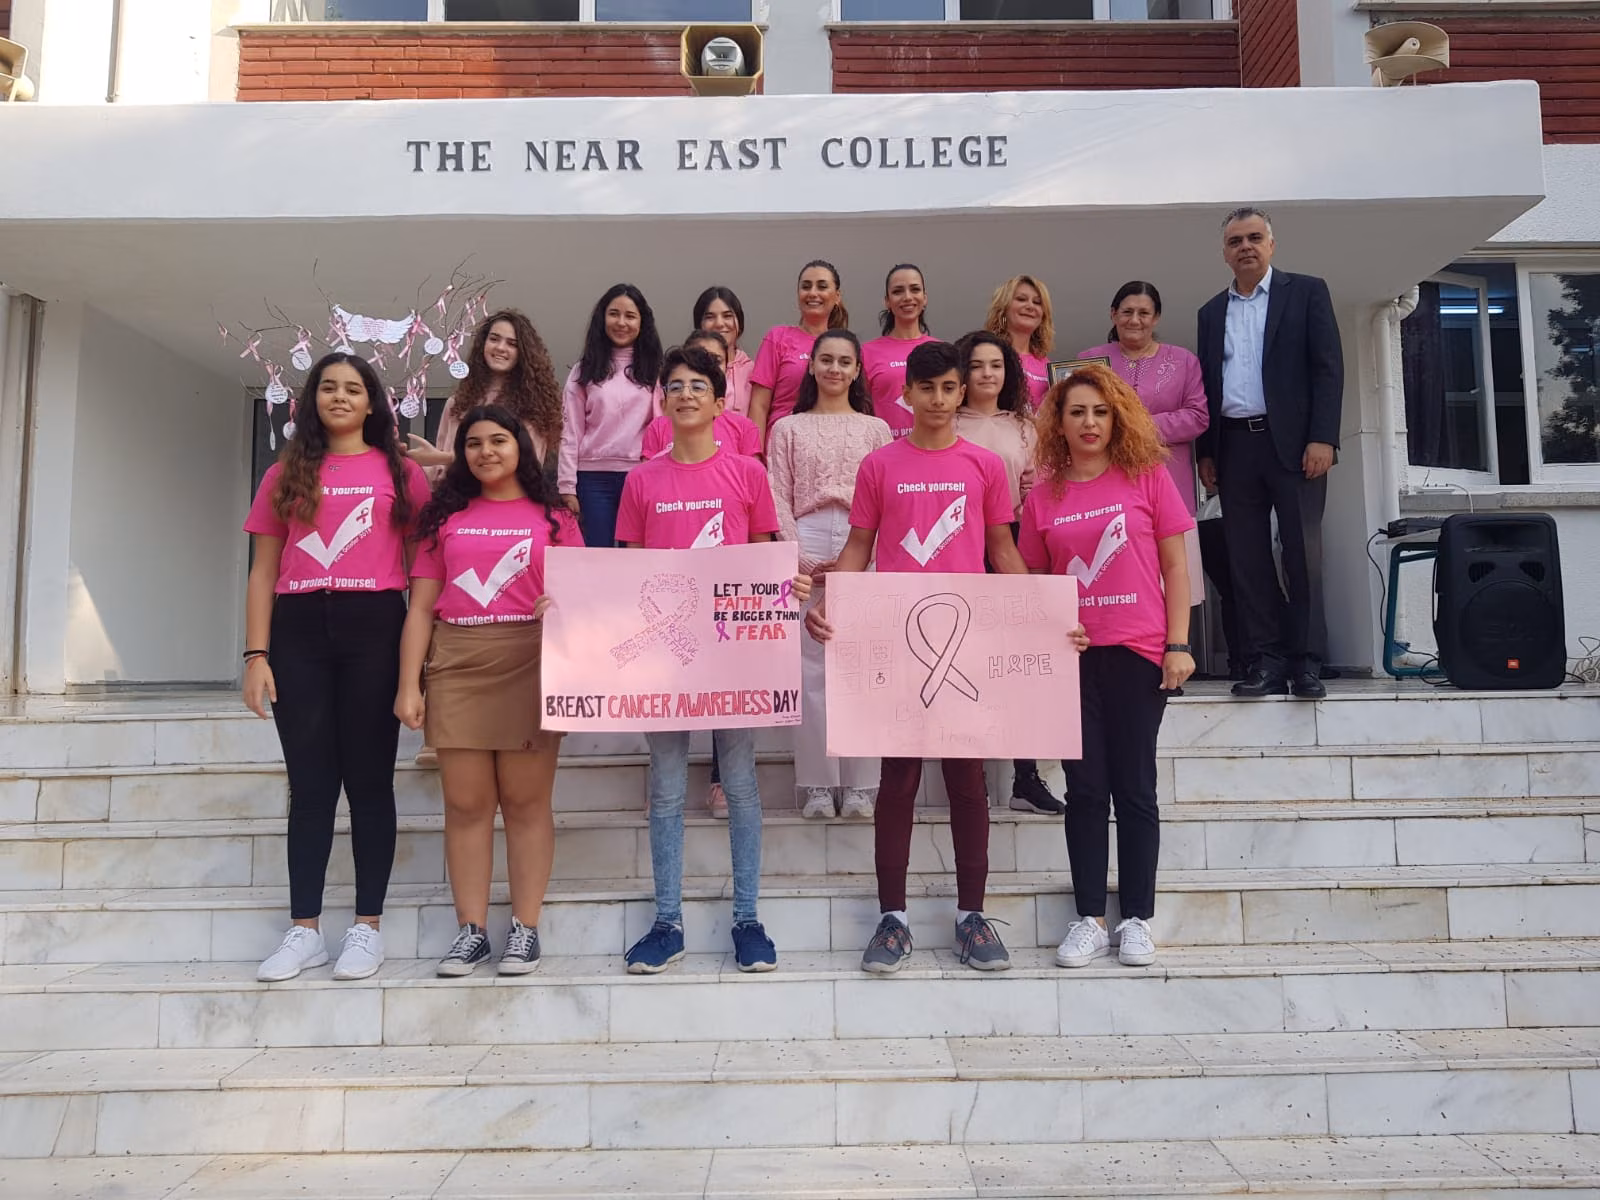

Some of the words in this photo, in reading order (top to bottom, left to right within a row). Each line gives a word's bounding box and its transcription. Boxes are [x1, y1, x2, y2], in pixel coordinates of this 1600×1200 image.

[406, 140, 492, 172] THE
[525, 138, 643, 172] NEAR
[677, 137, 788, 171] EAST
[821, 135, 1008, 169] COLLEGE
[332, 486, 373, 496] yourself
[897, 482, 926, 493] Check
[928, 482, 965, 493] yourself
[655, 500, 683, 513] Check
[685, 498, 722, 511] yourself
[1054, 514, 1082, 526] Check
[1084, 503, 1122, 520] yourself
[456, 528, 488, 536] Check
[490, 528, 532, 537] yourself
[289, 580, 298, 590] to
[300, 576, 333, 589] protect
[335, 577, 376, 589] yourself
[713, 583, 743, 598] LET
[750, 583, 780, 596] YOUR
[713, 597, 762, 611] FAITH
[1097, 593, 1137, 607] yourself
[713, 611, 728, 622] BE
[732, 611, 773, 622] BIGGER
[774, 610, 800, 621] THAN
[735, 622, 787, 641] FEAR
[546, 695, 606, 719] BREAST
[608, 694, 671, 719] CANCER
[675, 689, 772, 719] AWARENESS
[773, 689, 799, 713] DAY
